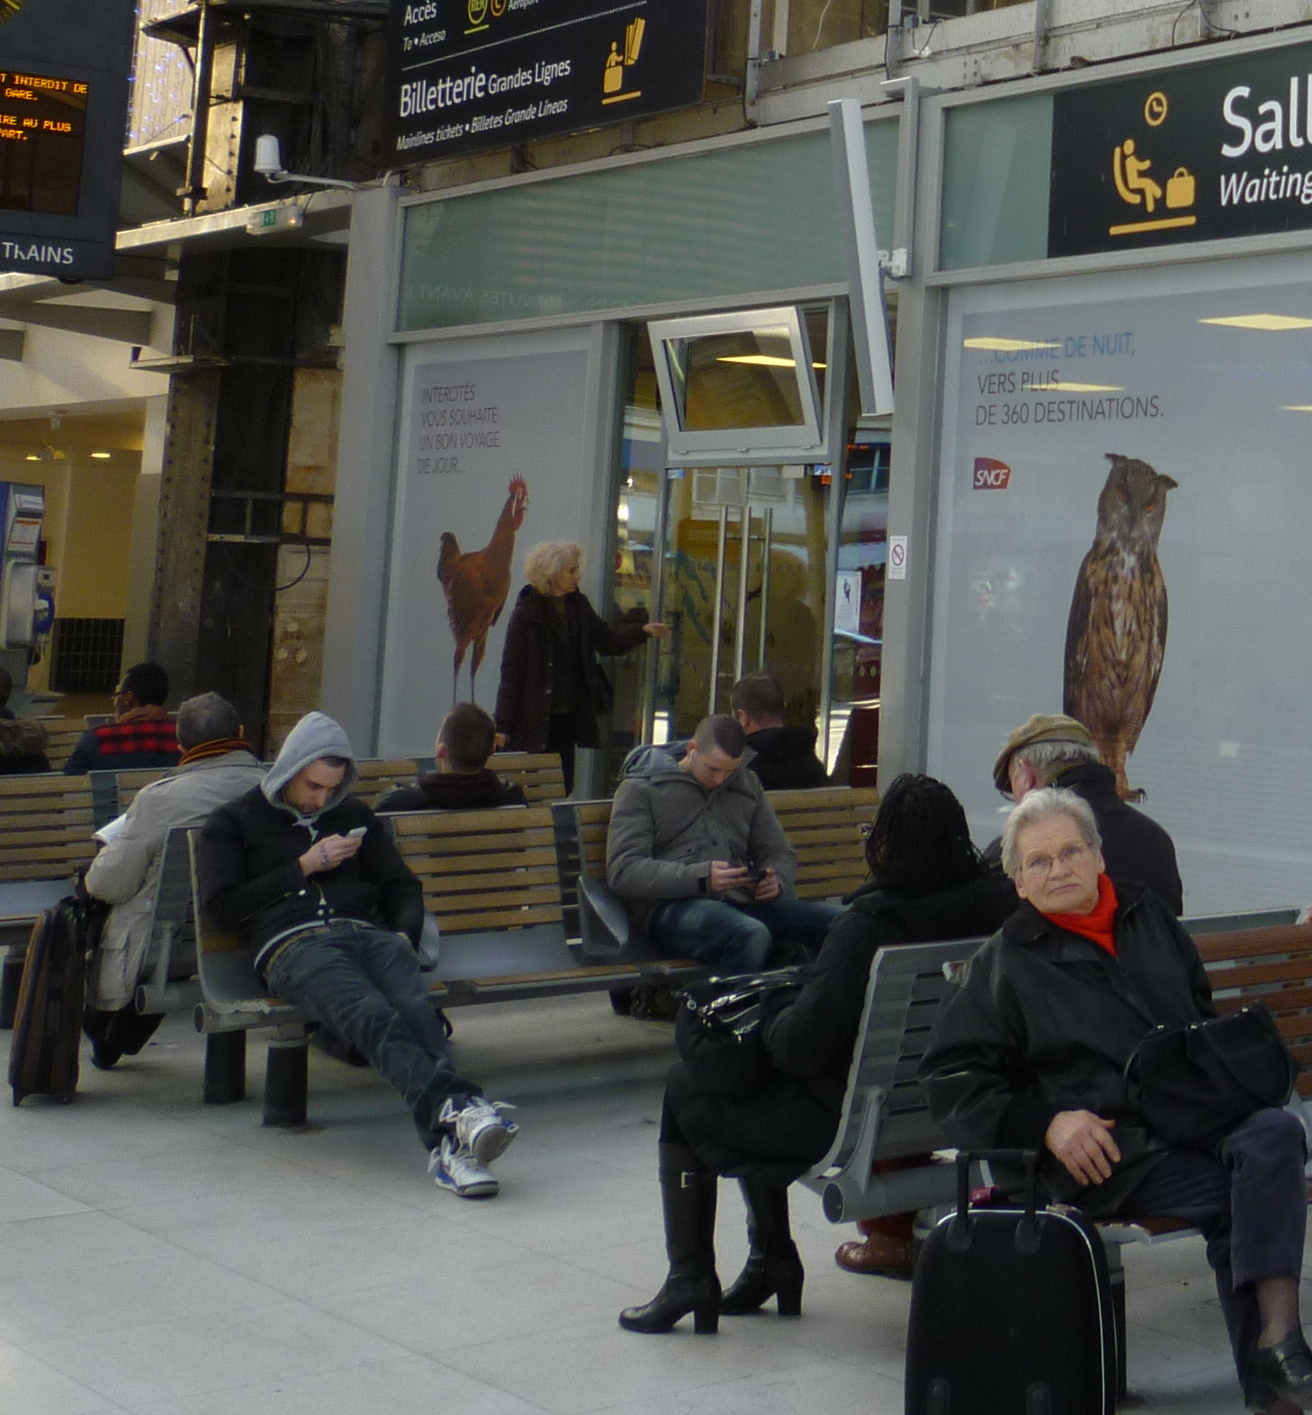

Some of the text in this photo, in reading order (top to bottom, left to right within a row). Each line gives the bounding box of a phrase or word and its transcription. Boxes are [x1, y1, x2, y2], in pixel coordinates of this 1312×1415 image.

[403, 0, 437, 27] Accès
[403, 29, 446, 52] To Acceso
[4, 88, 38, 101] GARE.
[13, 75, 69, 91] INTERDIT
[73, 83, 89, 94] DE
[400, 59, 571, 118] Billetterie Grandes Lignes
[22, 119, 39, 129] AU
[43, 120, 72, 132] PLUS
[436, 123, 464, 142] tickets
[471, 115, 504, 133] Billetes
[504, 103, 537, 125] Grande
[1064, 335, 1087, 358] DE
[1092, 332, 1135, 356] NUIT,
[978, 369, 1060, 395] VERS PLUS
[422, 406, 499, 427] VOUS SOUHAITE
[975, 395, 1164, 426] DE 360 DESTINATIONS.
[421, 434, 434, 451] UN
[436, 433, 457, 450] BON
[417, 458, 430, 474] DE
[974, 468, 1008, 486] SNCF
